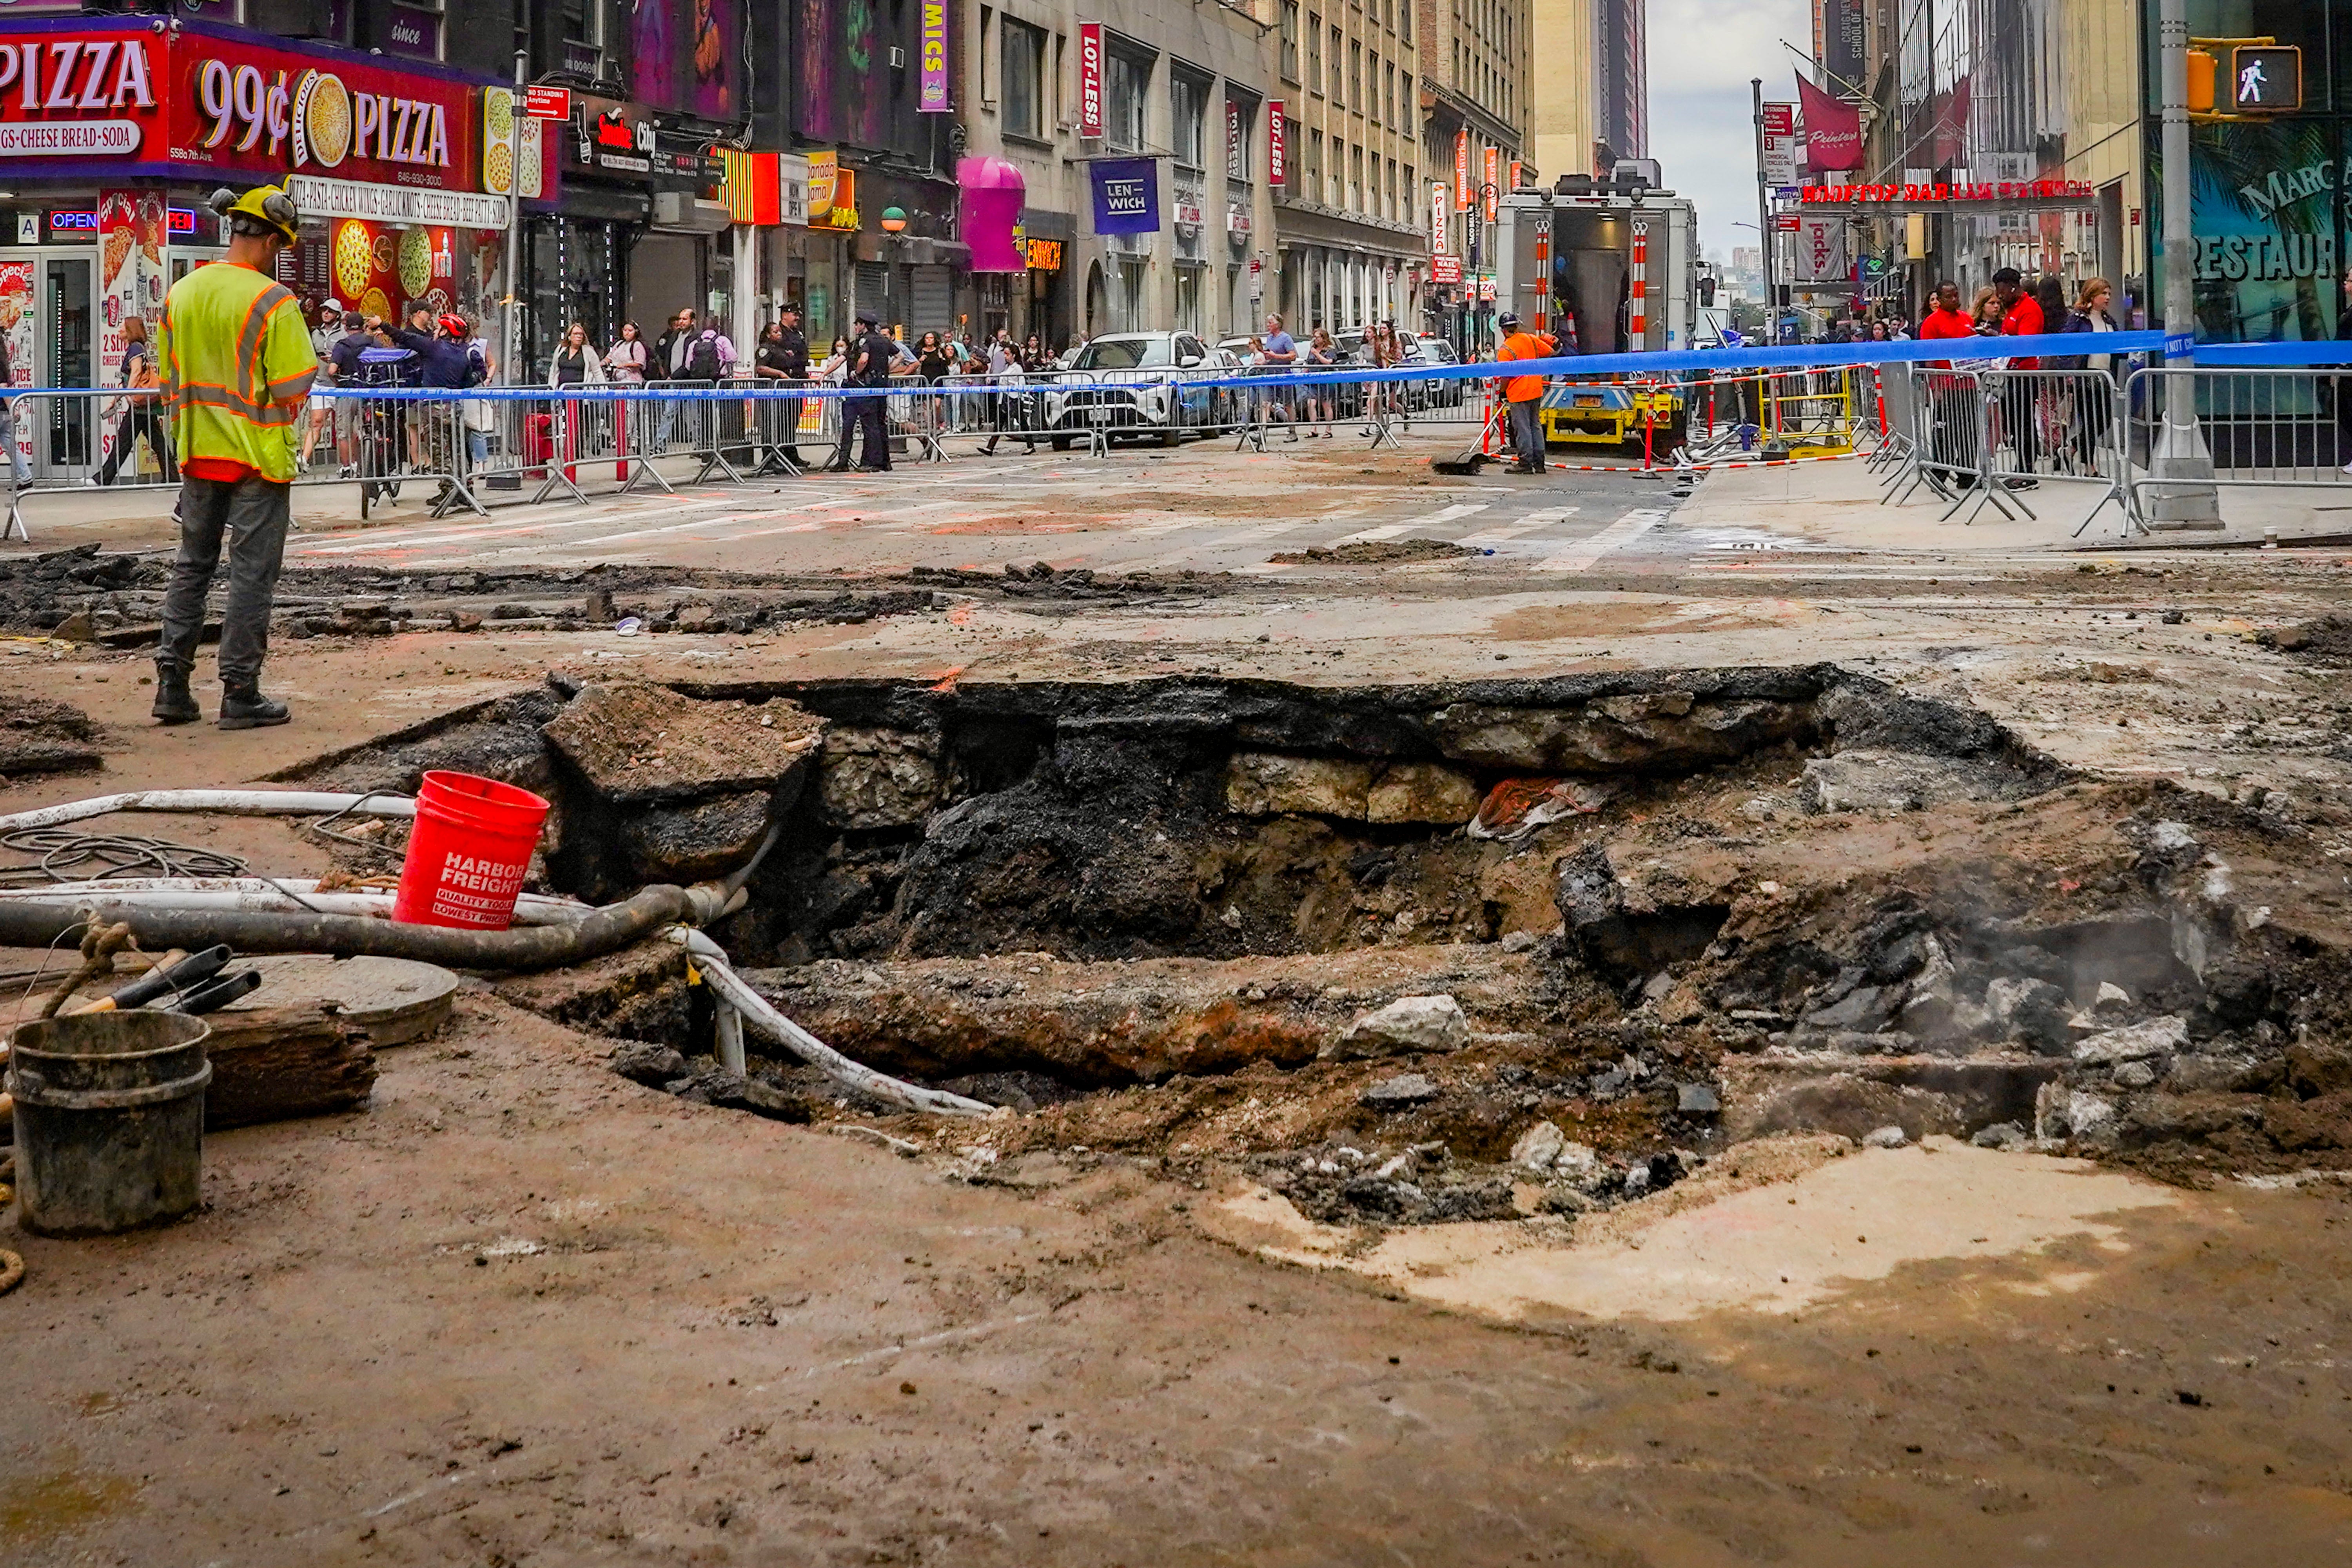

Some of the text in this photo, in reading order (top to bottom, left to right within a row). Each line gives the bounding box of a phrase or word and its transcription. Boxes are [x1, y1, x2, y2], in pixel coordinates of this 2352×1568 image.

[1851, 11, 1861, 23] OF
[392, 20, 420, 45] since
[925, 0, 943, 72] MICS
[1851, 24, 1862, 58] SCHOOL
[1083, 36, 1098, 125] LOT-LESS
[537, 90, 564, 98] STANDING
[201, 58, 290, 156] 99¢
[296, 73, 316, 160] DELICIOUS
[21, 129, 58, 147] CHEESE
[62, 128, 96, 147] BREAD
[102, 127, 130, 146] SODA
[354, 91, 450, 167] PIZZA
[637, 121, 656, 159] City
[1271, 111, 1283, 176] LOT-LESS
[1767, 138, 1772, 149] 3
[309, 181, 328, 210] PASTA
[331, 184, 356, 212] CHICKEN
[358, 187, 377, 214] WINGS
[381, 189, 401, 216] GARLIC
[402, 191, 420, 218] KNOTS
[423, 193, 442, 220] CHEESE
[443, 196, 460, 221] BREAD
[808, 186, 827, 201] ama
[1107, 197, 1145, 209] WICH
[1801, 184, 1898, 203] ROOFTOP
[1903, 183, 1948, 201] BAR
[22, 219, 34, 235] A
[52, 213, 97, 227] OPEN
[223, 219, 229, 234] A
[1435, 196, 1444, 250] PIZZA
[1808, 223, 1830, 274] jacks.
[1784, 325, 1793, 335] P
[103, 334, 109, 352] 2
[2169, 339, 2182, 352] NOT
[445, 851, 525, 879] HARBOR
[440, 867, 521, 894] FREIGHT
[439, 890, 485, 906] QUALITY
[435, 904, 478, 920] LOWEST
